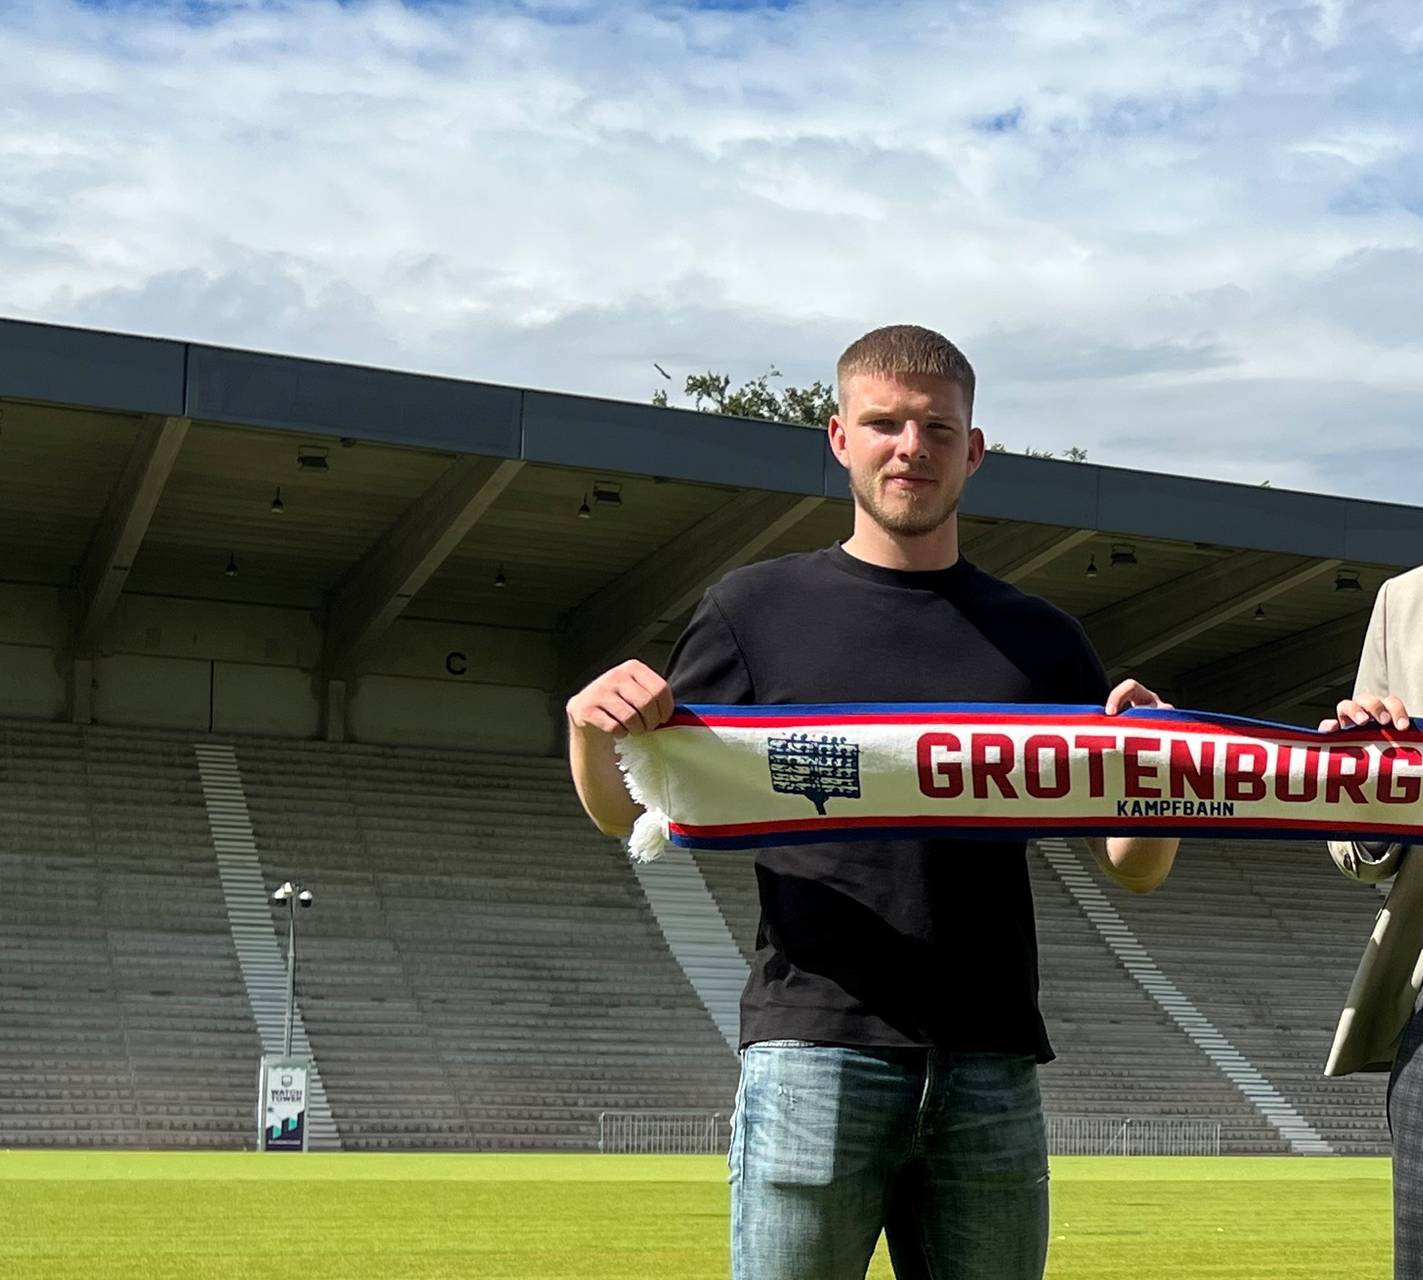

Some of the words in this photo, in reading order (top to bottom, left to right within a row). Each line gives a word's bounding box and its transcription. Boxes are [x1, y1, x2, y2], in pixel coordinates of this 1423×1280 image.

[446, 652, 467, 675] C
[917, 732, 1423, 804] GROTENBURG
[1117, 800, 1234, 816] KAMPFBAHN
